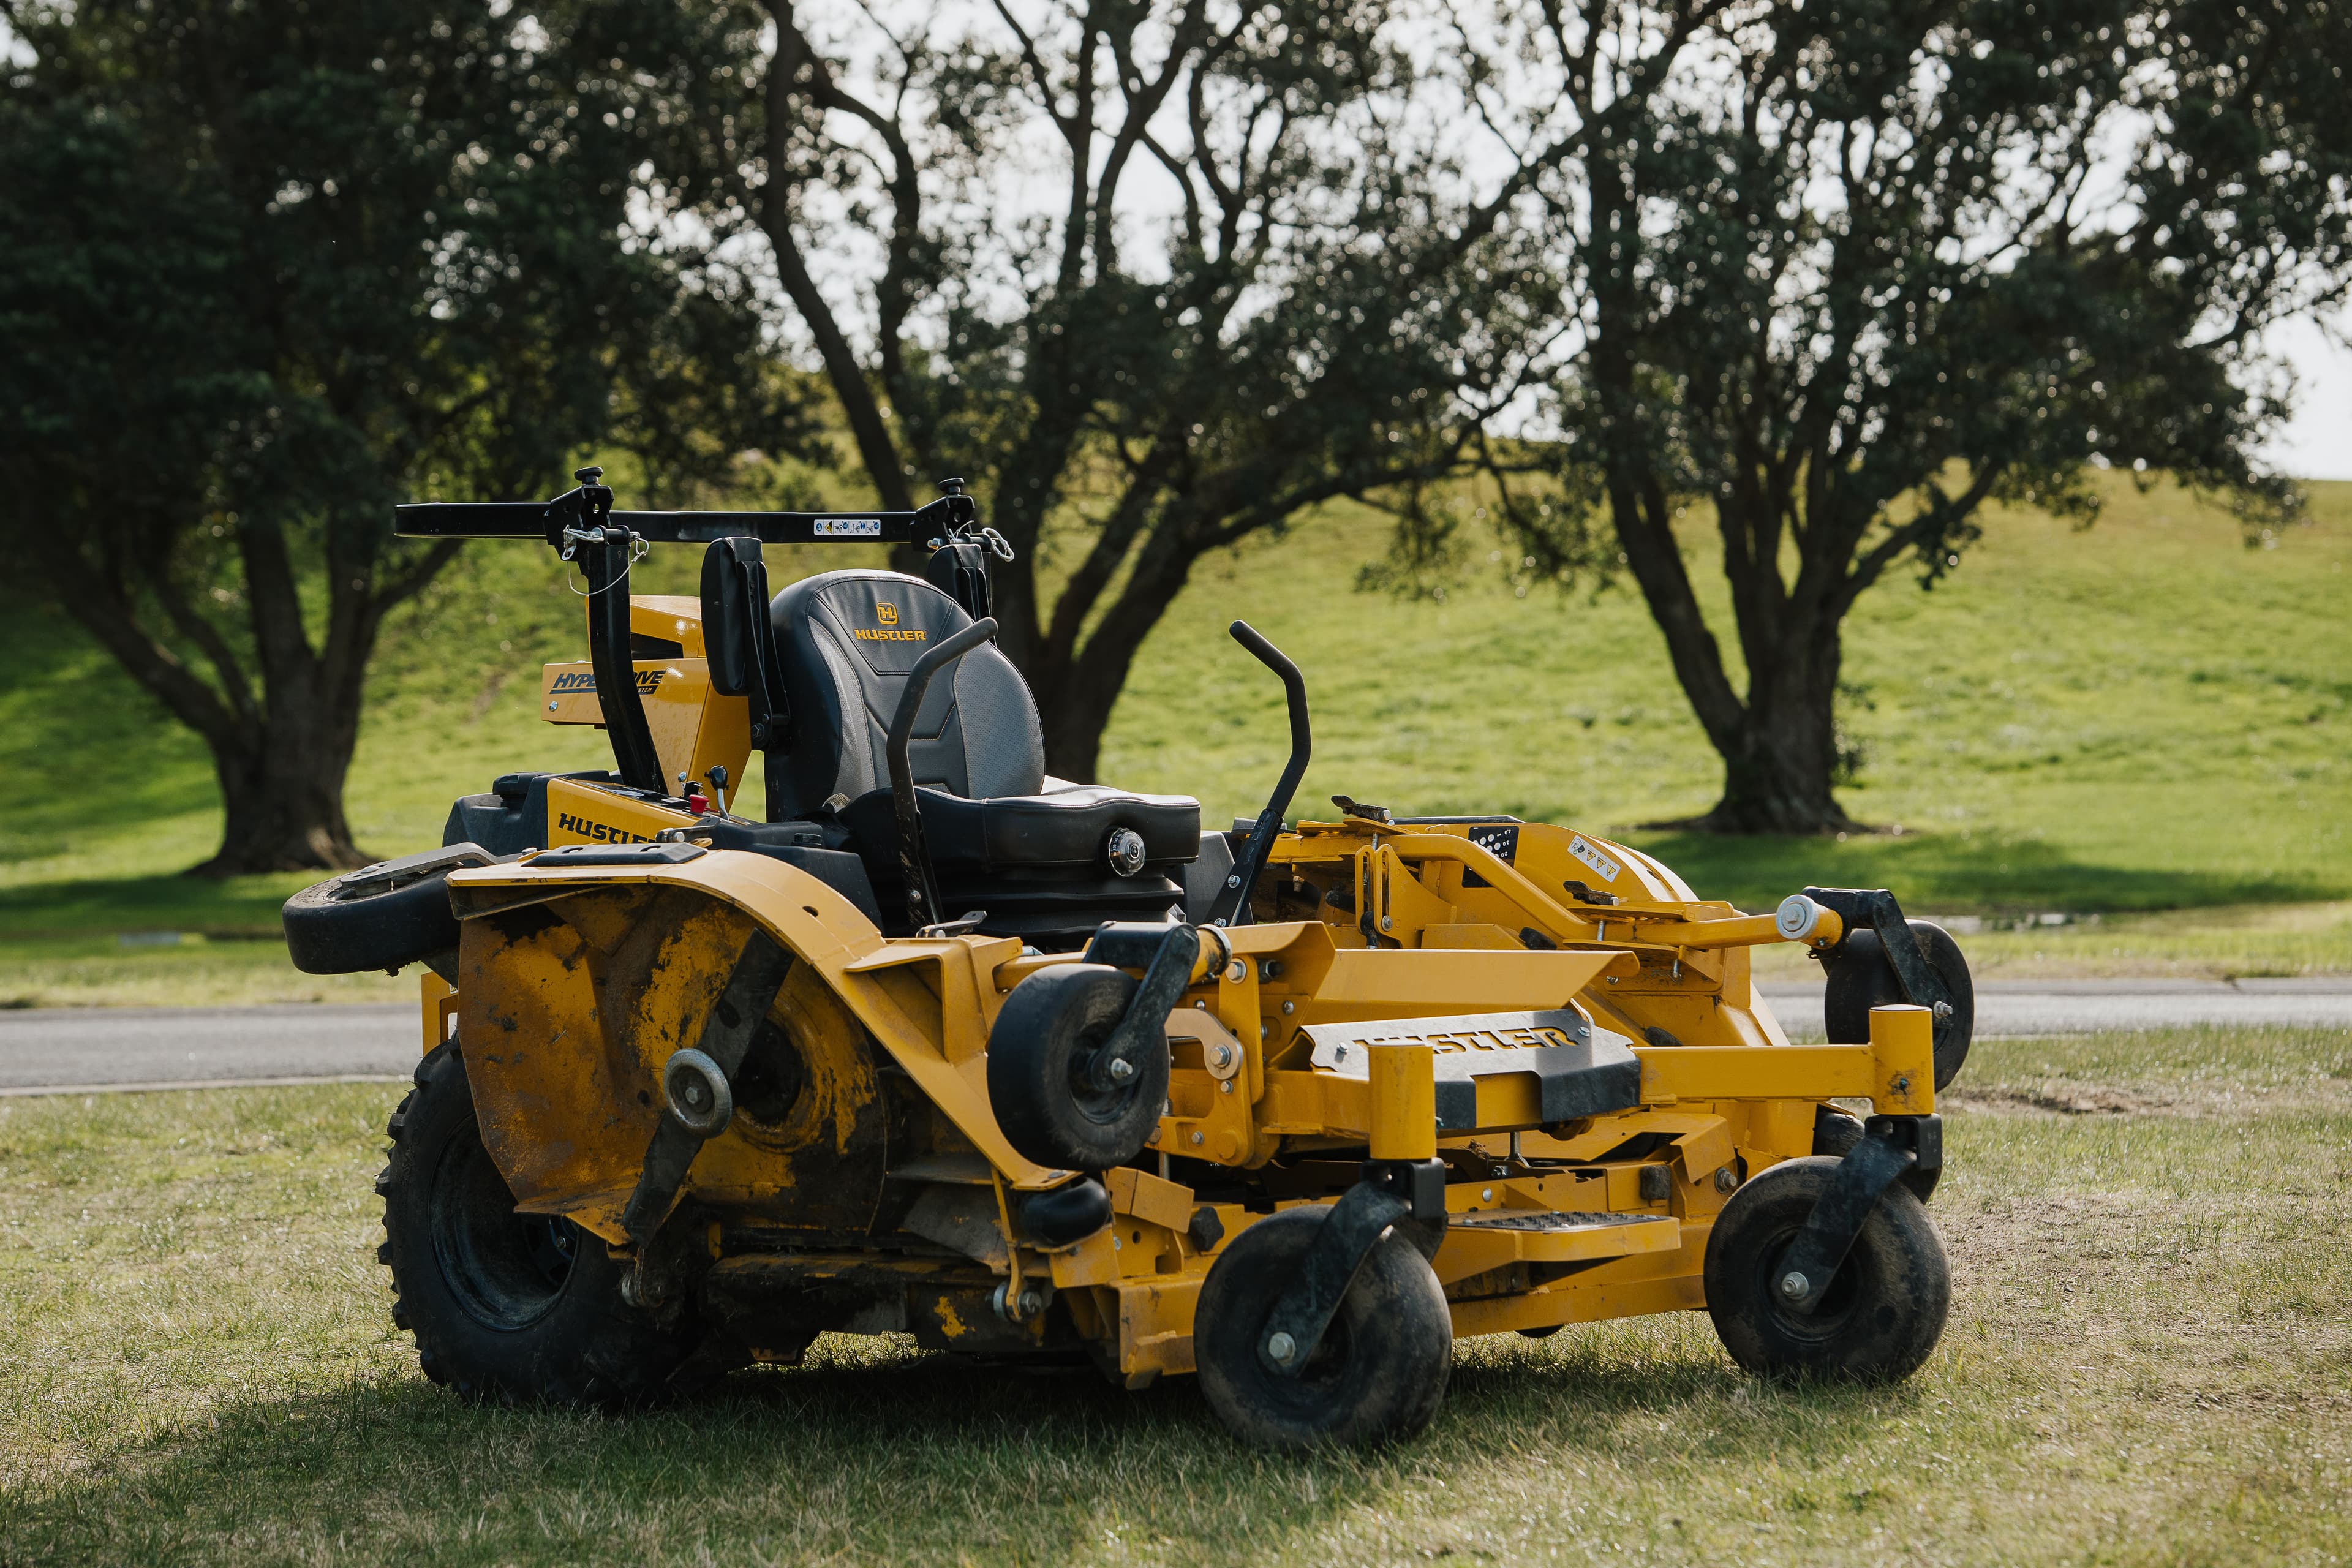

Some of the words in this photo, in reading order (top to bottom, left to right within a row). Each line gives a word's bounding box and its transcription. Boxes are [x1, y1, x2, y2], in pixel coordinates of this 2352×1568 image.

[853, 628, 927, 641] HUSTLER
[558, 813, 656, 844] HUSTLE
[1352, 1026, 1580, 1055] STLER
